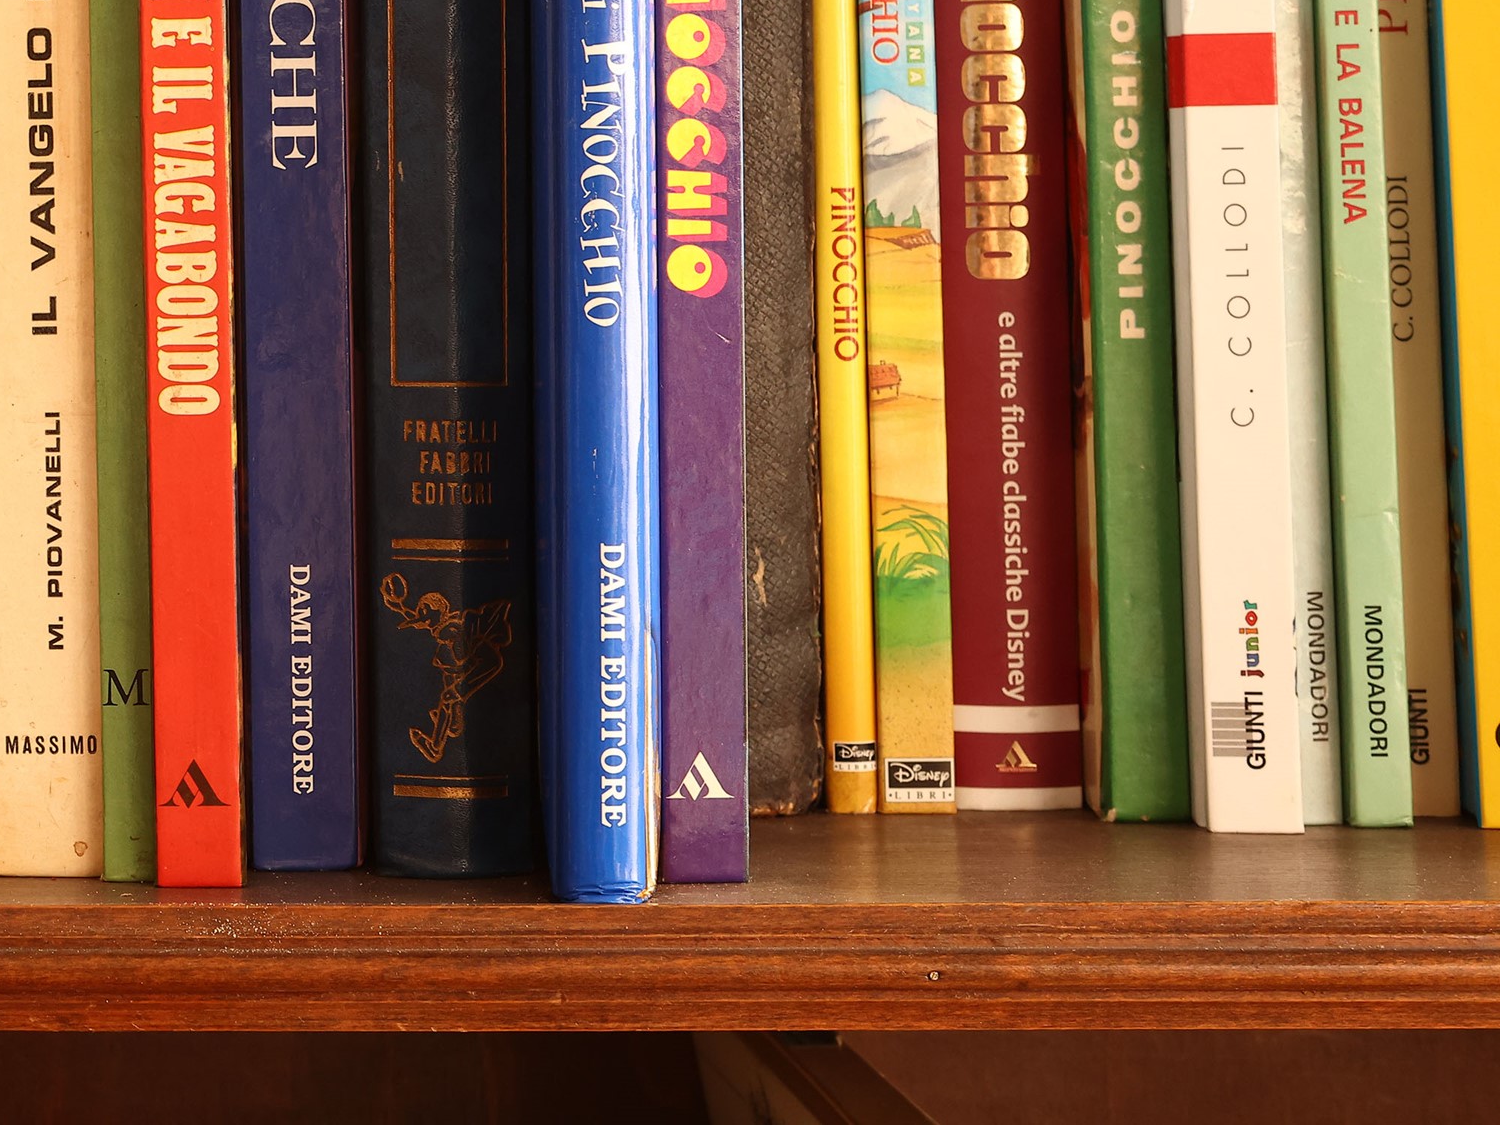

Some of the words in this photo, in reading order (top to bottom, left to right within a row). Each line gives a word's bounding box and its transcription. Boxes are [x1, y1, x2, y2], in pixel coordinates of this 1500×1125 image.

[150, 16, 214, 49] E
[1334, 10, 1359, 26] E
[151, 65, 214, 115] IL
[1335, 44, 1362, 81] LA
[27, 26, 57, 272] VANGELO
[580, 38, 634, 328] PINOCCHIO
[1109, 10, 1147, 340] PINOCCHIO
[1338, 98, 1368, 224] BALENA
[152, 123, 221, 418] VAGABONDO
[830, 187, 860, 362] PINOCCHIO
[1221, 147, 1253, 357] COLLODI
[1386, 176, 1413, 308] COLLODI
[31, 295, 57, 336] IL
[998, 311, 1015, 328] e
[1392, 316, 1414, 343] C.
[998, 334, 1023, 399] altre
[404, 419, 499, 446] FRATELLI
[1001, 404, 1026, 475] fiabe
[1230, 388, 1255, 427] C.
[411, 480, 493, 506] EDITORI
[419, 450, 492, 475] FABBRI
[45, 411, 65, 599] PIOVANELLI
[1002, 480, 1030, 602] classiche
[289, 563, 312, 645] DAMI
[599, 543, 626, 642] DAMI
[48, 615, 66, 651] M.
[1001, 609, 1030, 702] Disney
[1239, 599, 1265, 678] junior
[1306, 591, 1329, 743] MONDADORI
[102, 669, 150, 706] M
[1364, 605, 1389, 758] MONDADORI
[5, 733, 98, 756] MASSIMO
[290, 655, 316, 796] EDITORE
[599, 655, 628, 828] EDITORE
[1244, 690, 1267, 770] GIUNTI
[1408, 688, 1430, 765] GIUNTI
[894, 791, 947, 800] LIBRI
